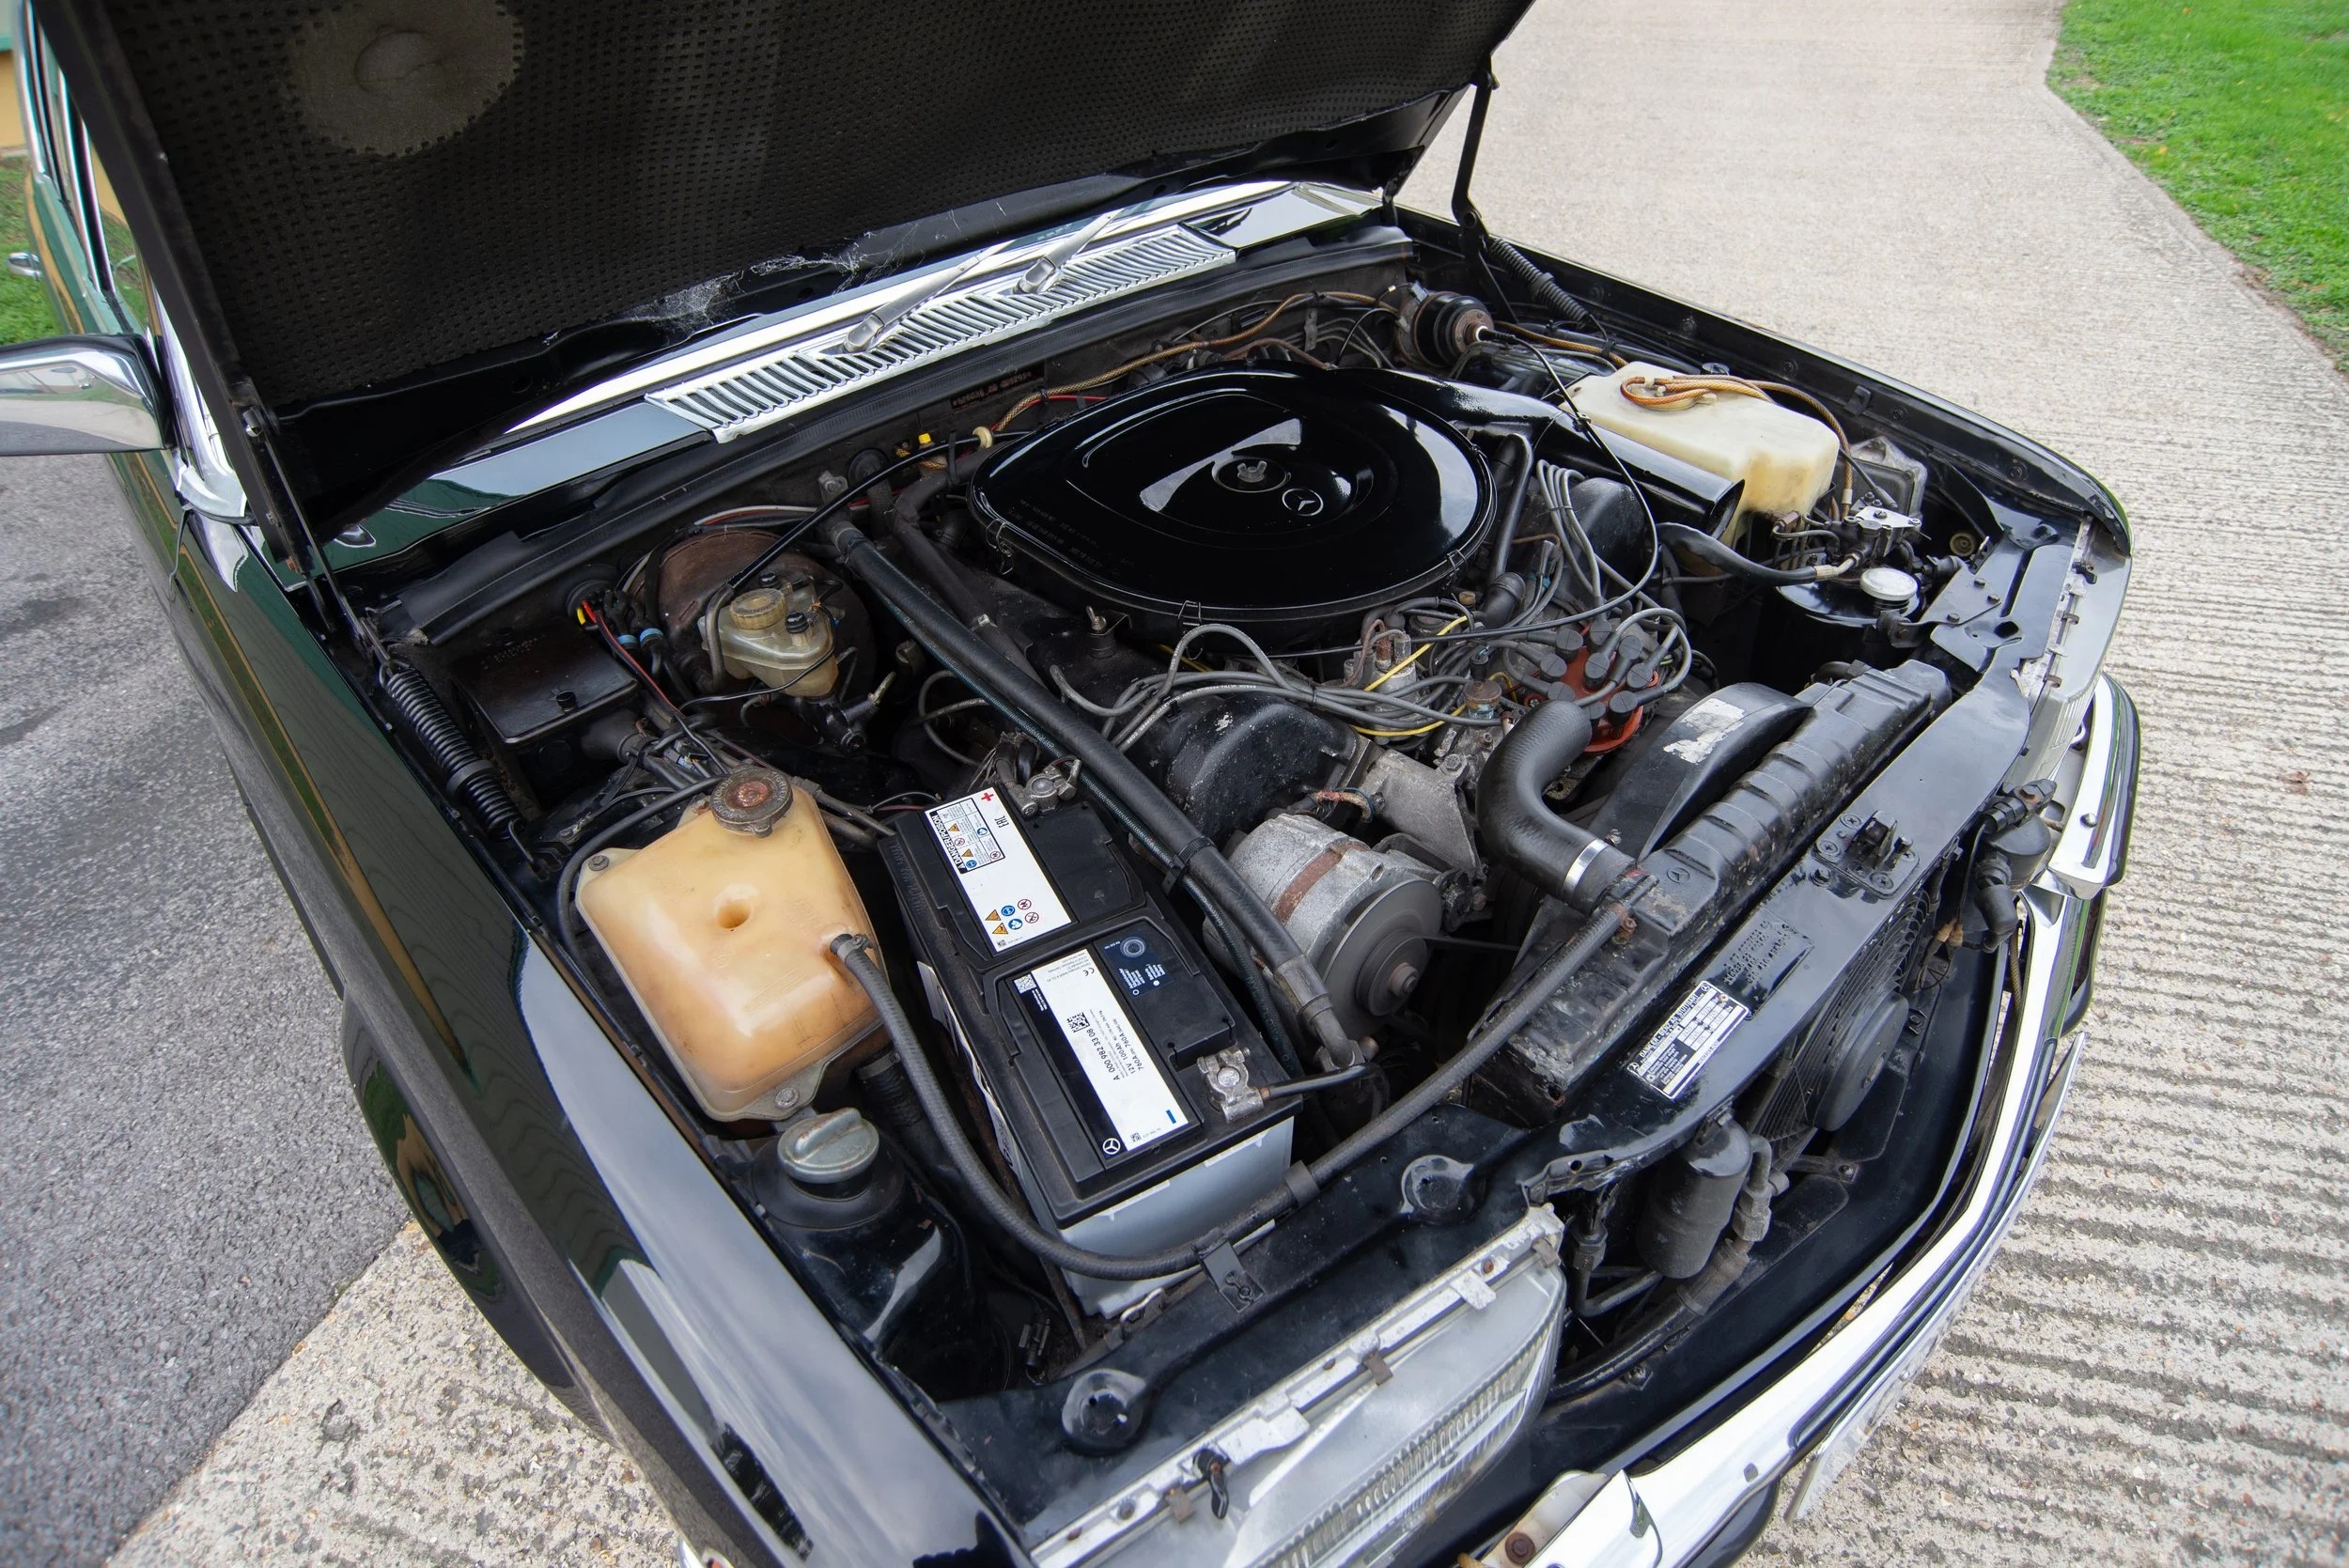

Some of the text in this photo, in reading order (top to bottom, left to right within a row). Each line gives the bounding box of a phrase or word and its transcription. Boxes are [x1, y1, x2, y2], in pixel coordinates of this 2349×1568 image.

[1086, 1028, 1096, 1038] 08
[1119, 1032, 1131, 1048] 760A
[1097, 1046, 1107, 1060] 982
[1115, 1042, 1128, 1061] 100Ah
[1103, 1059, 1115, 1073] 000
[1126, 1063, 1136, 1075] 12V
[1132, 1056, 1144, 1071] 760A
